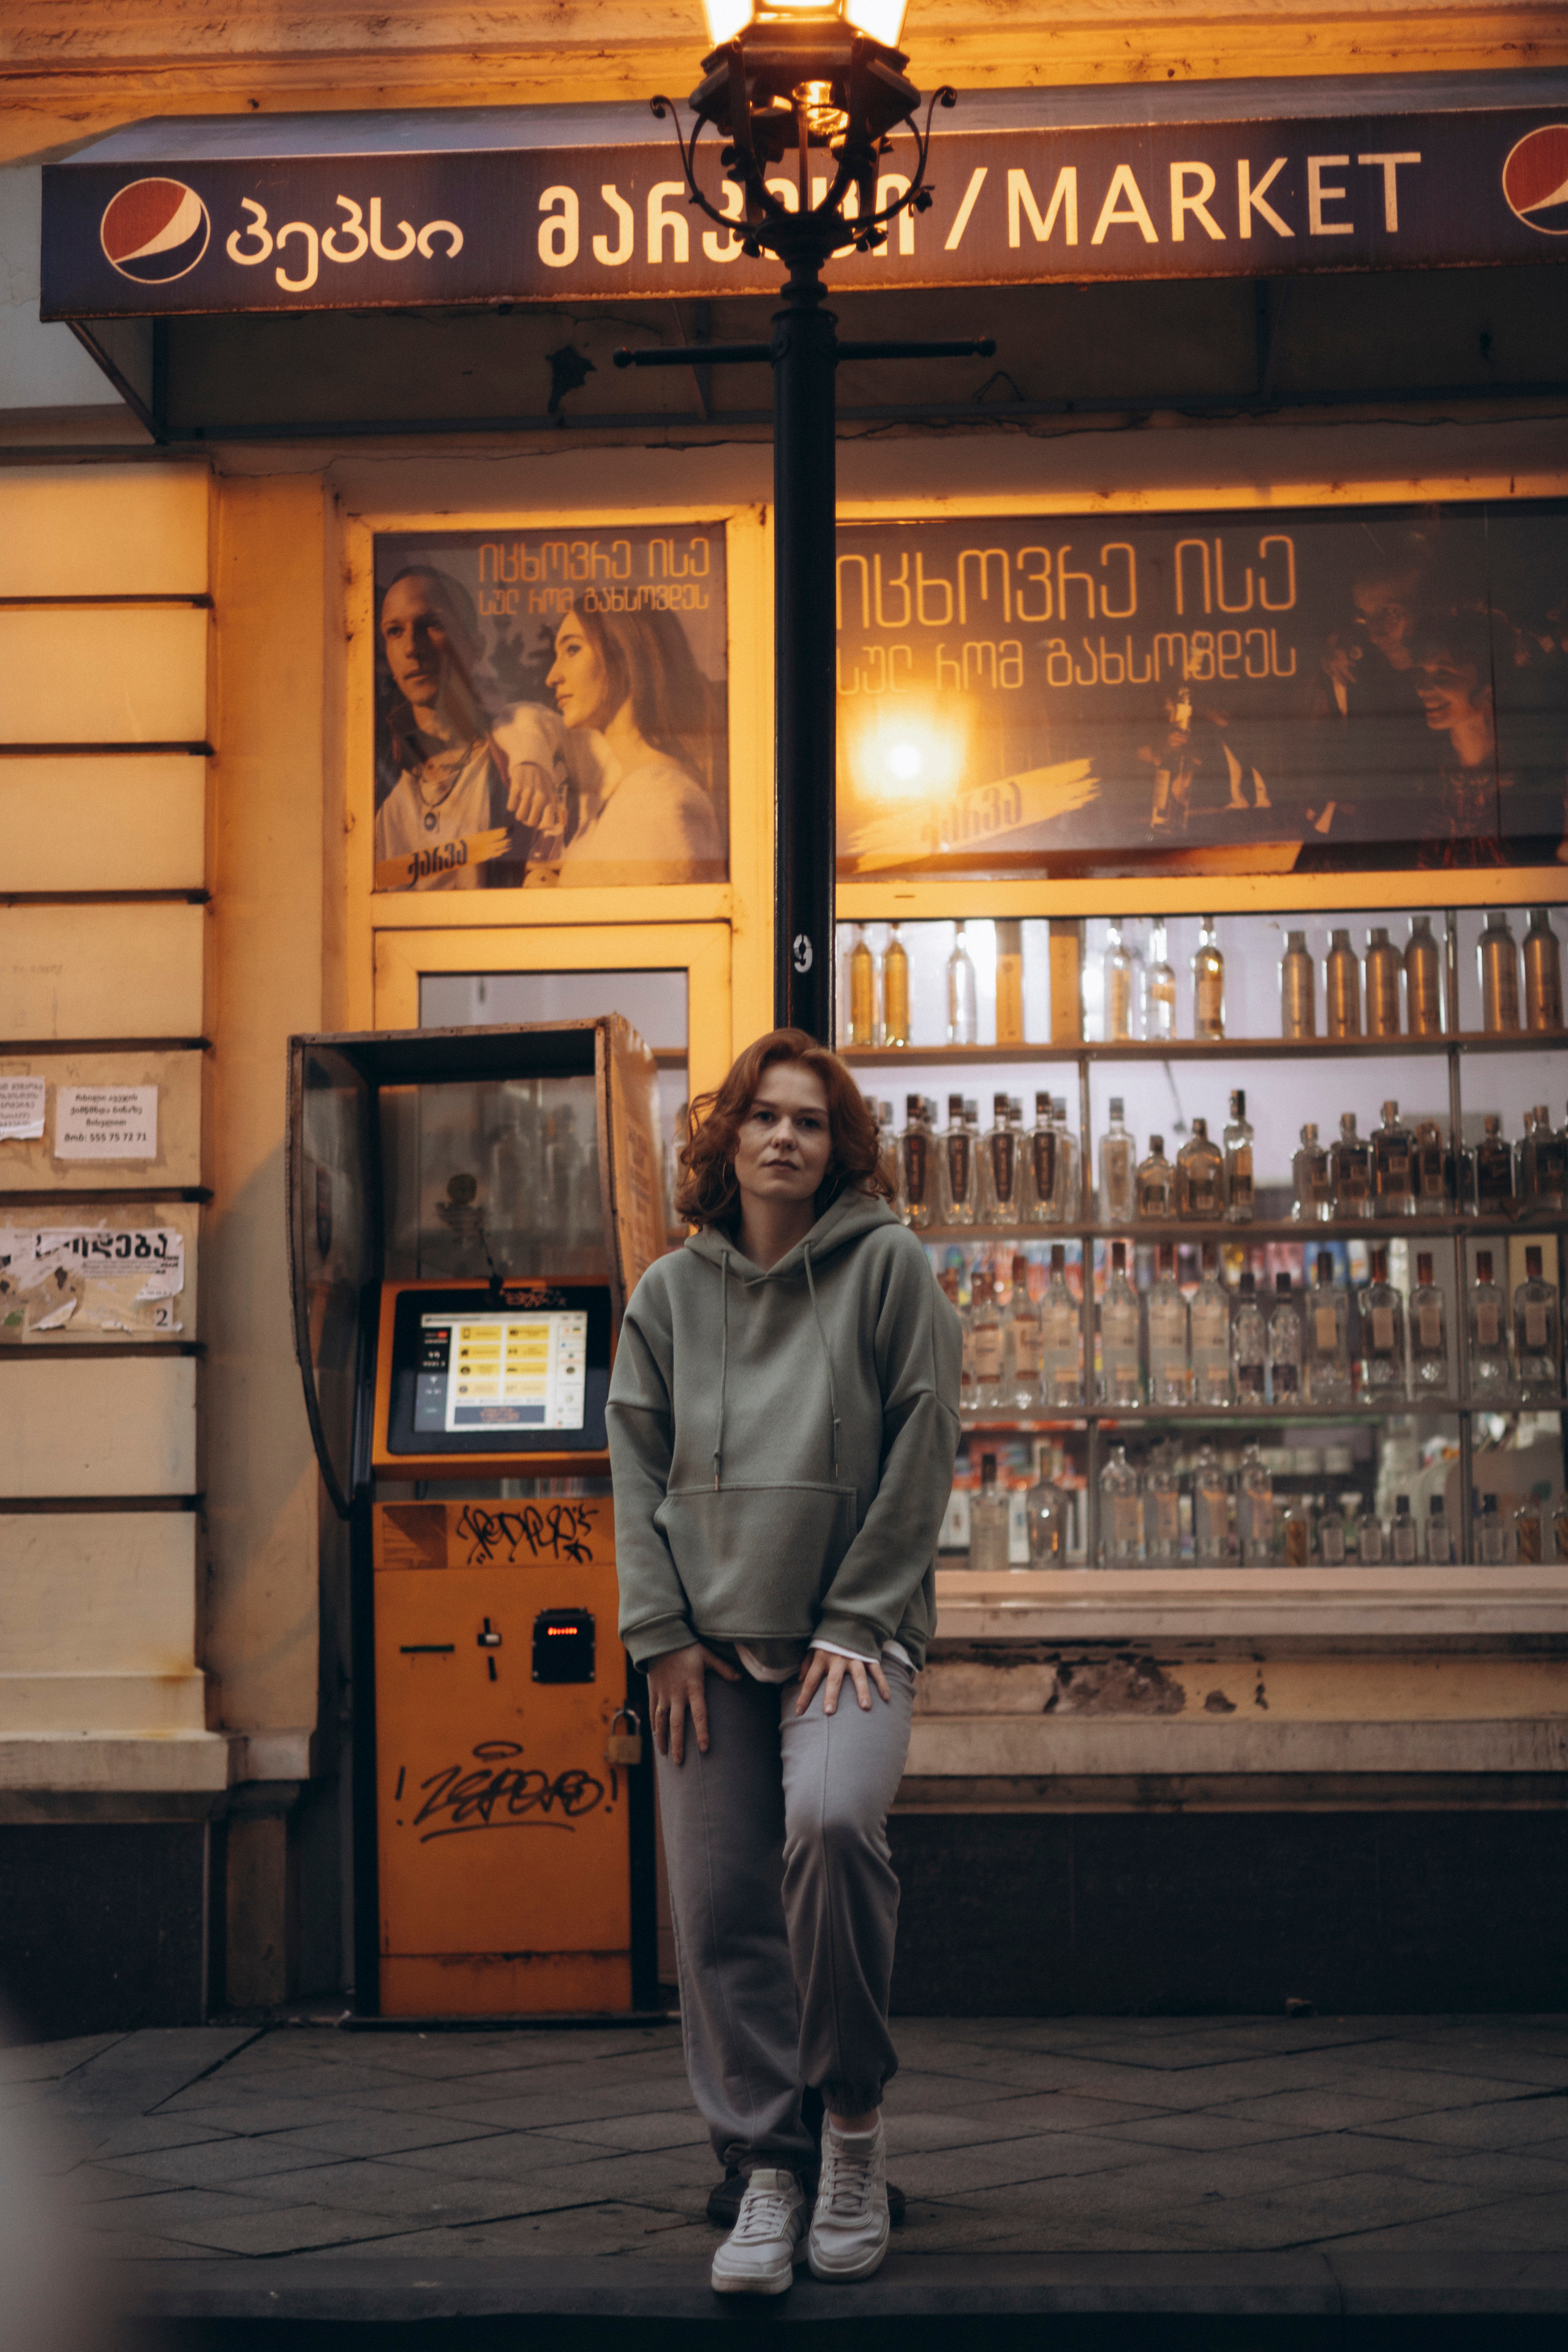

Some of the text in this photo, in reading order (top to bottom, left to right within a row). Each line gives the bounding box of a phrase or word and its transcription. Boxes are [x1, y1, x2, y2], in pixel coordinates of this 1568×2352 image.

[1008, 151, 1422, 247] MARKET
[227, 194, 464, 292] პეპსი
[478, 537, 710, 582] იცხოვრე ისე
[837, 535, 1296, 630] იცხოვრე ისე
[528, 587, 575, 614] რომ
[935, 639, 1024, 692] რომ
[406, 839, 467, 890] ქარვა
[793, 933, 813, 974] 9
[90, 1133, 107, 1142] 555
[109, 1133, 120, 1142] 75
[123, 1133, 134, 1142] 72
[137, 1133, 147, 1141] 71
[156, 1308, 168, 1327] 2
